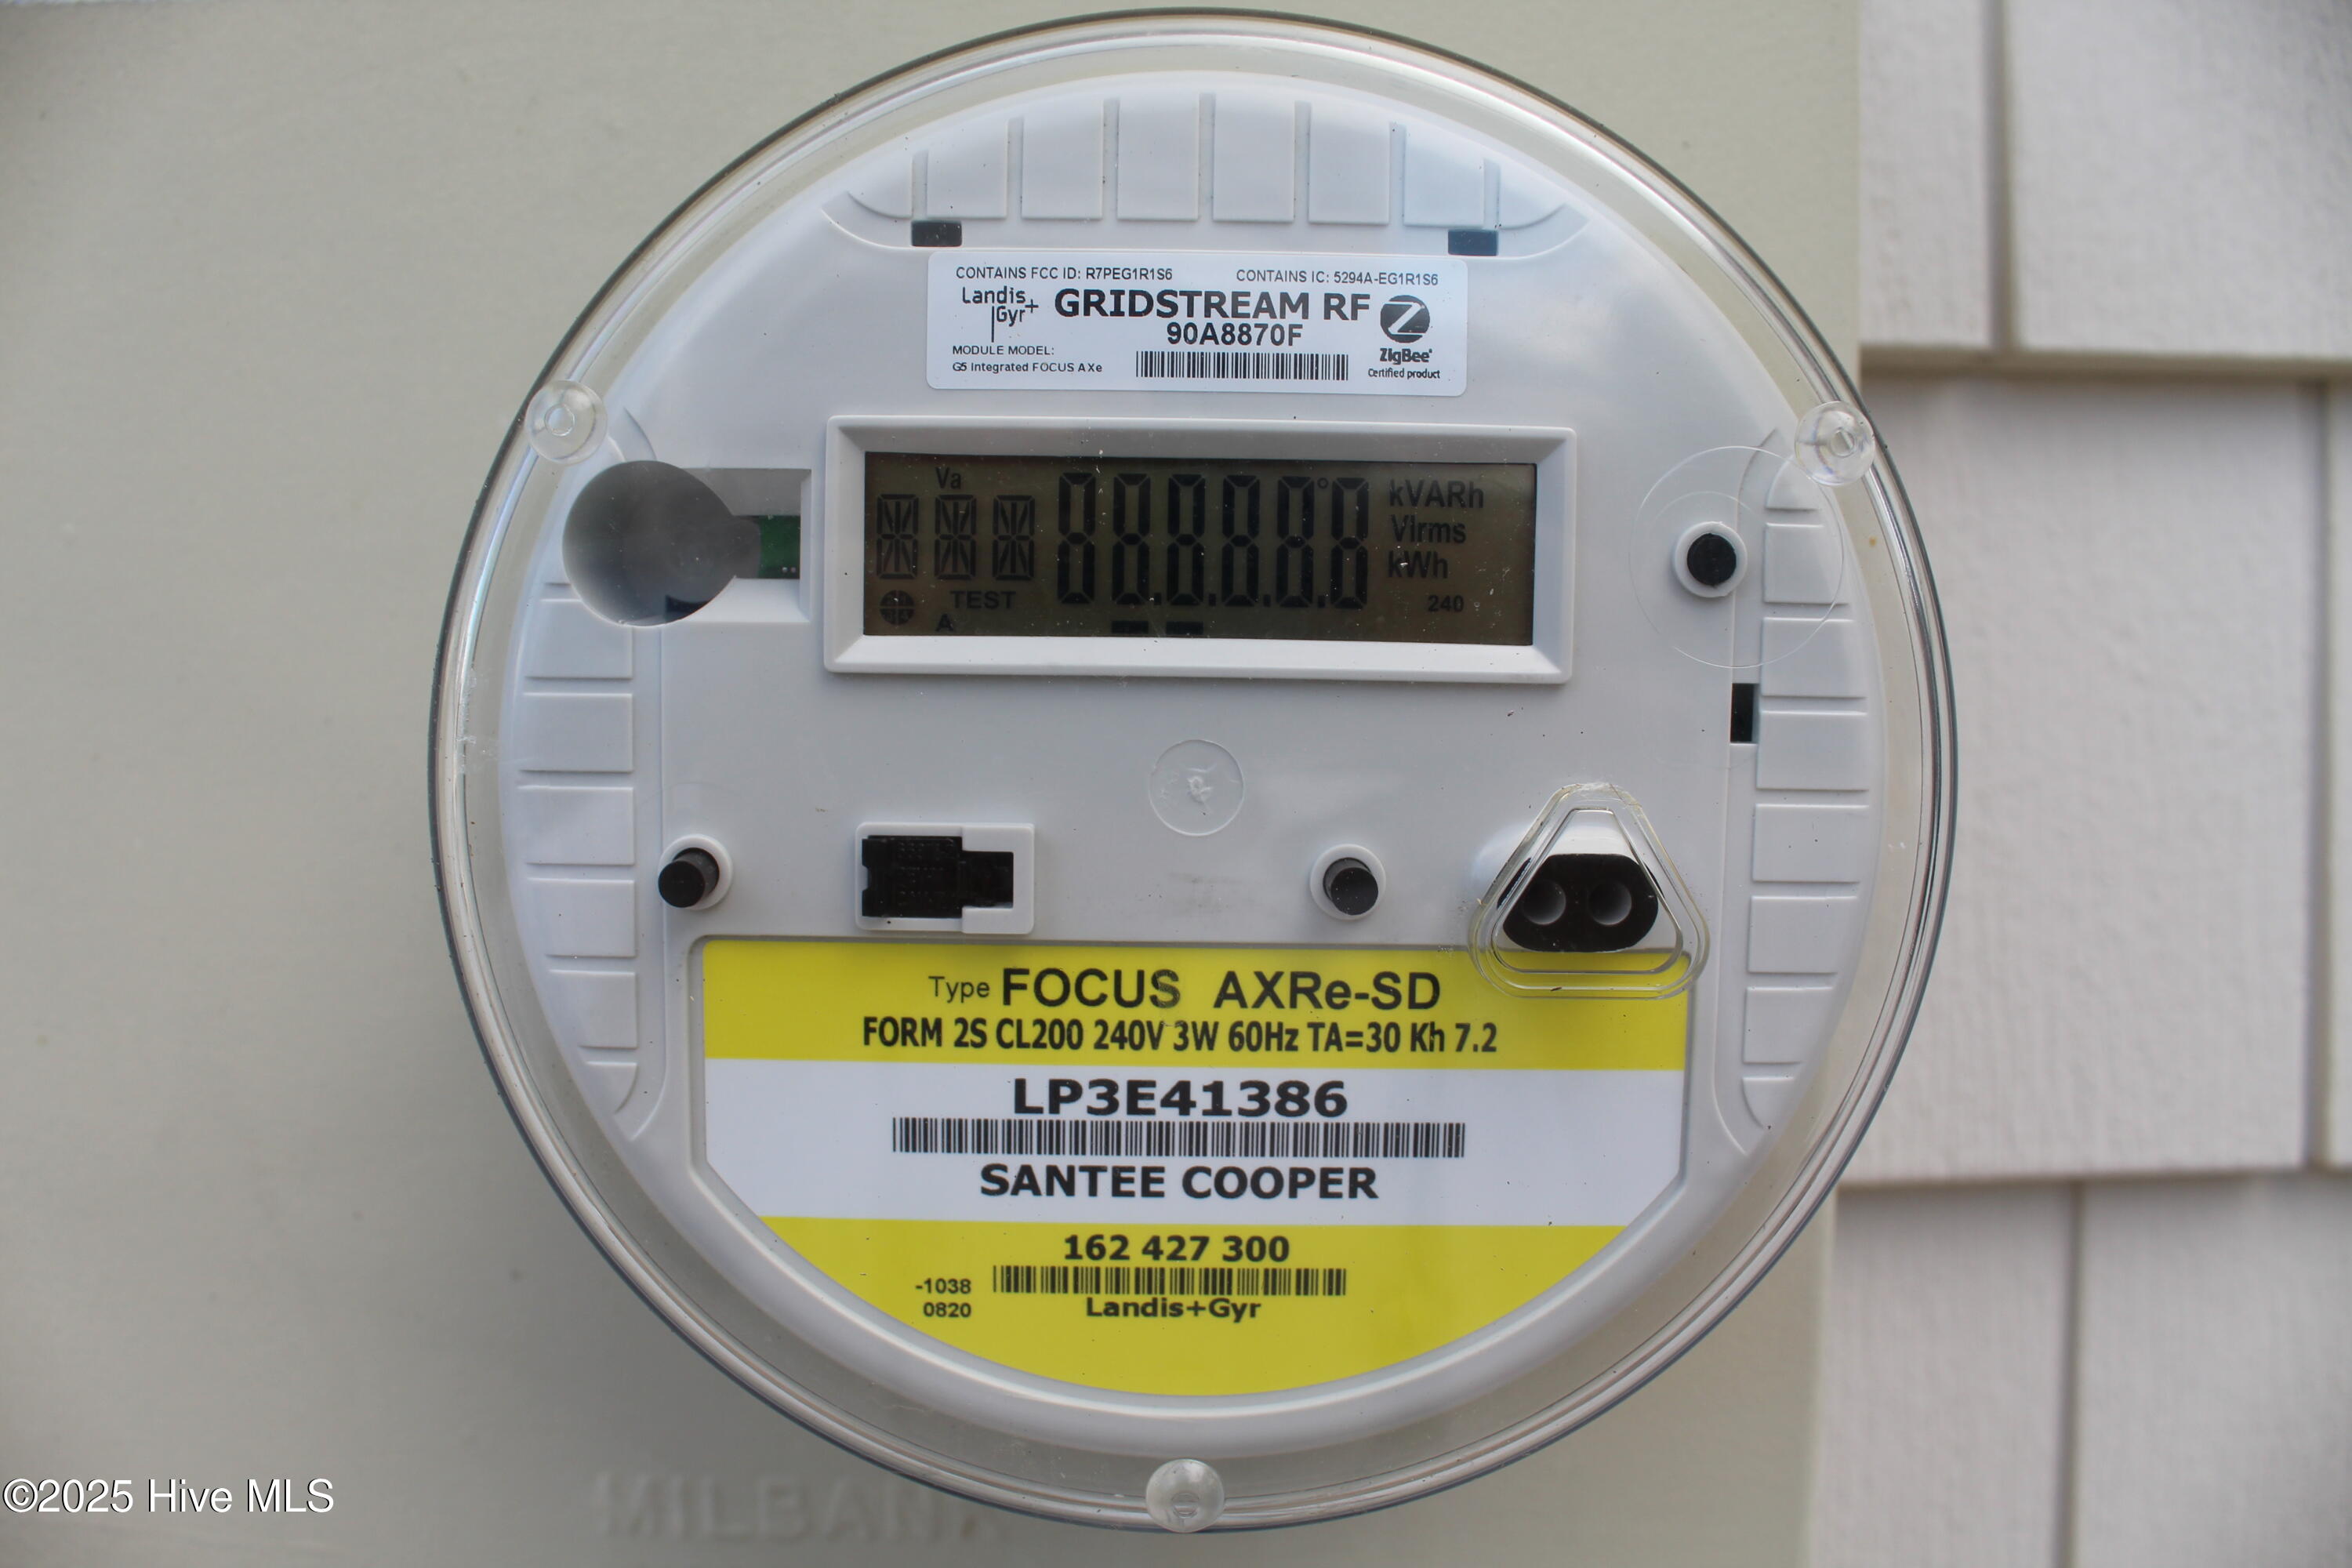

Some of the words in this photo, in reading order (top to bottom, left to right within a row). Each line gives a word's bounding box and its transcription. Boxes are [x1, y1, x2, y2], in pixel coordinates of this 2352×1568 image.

[956, 267, 1027, 279] CONTAINS
[1031, 267, 1058, 279] FCC
[1063, 267, 1080, 280] ID:
[1086, 267, 1173, 281] R7PEG1R1S6
[1236, 269, 1307, 283] CONTAINS
[1312, 270, 1329, 283] IC:
[1334, 270, 1439, 286] 5294A-EG1R1S6
[962, 285, 1026, 304] Landis
[1054, 288, 1309, 320] GRIDSTREAM
[1323, 292, 1370, 321] RF
[1167, 321, 1303, 347] 90A8870F
[953, 345, 1004, 355] MODULE
[1007, 345, 1054, 355] MODEL:
[952, 361, 967, 372] G5
[971, 362, 1029, 375] Integrated
[1032, 362, 1075, 372] FOCUS
[1367, 367, 1405, 379] Certified
[1406, 368, 1440, 379] product
[1388, 550, 1448, 579] kWh
[950, 590, 1016, 609] TEST
[1428, 594, 1465, 612] 240
[927, 975, 990, 1001] Type
[1003, 967, 1181, 1009] FOCUS
[1213, 971, 1441, 1011] AXRe-SD
[863, 1016, 942, 1047] FORM
[953, 1017, 988, 1049] 2S
[996, 1018, 1083, 1051] CL200
[1094, 1018, 1164, 1051] 240V
[1173, 1020, 1219, 1051] 3W
[1228, 1020, 1299, 1052] 60Hz
[1307, 1021, 1401, 1053] TA=30
[1410, 1022, 1445, 1052] Kh
[1454, 1022, 1497, 1053] 7.2
[1014, 1078, 1348, 1118] LP3E41386
[981, 1163, 1166, 1198] SANTEE
[1181, 1166, 1379, 1200] COOPER
[1065, 1234, 1131, 1261] 162
[1142, 1235, 1210, 1261] 427
[1222, 1235, 1290, 1263] 300
[915, 1277, 971, 1294] -1038
[923, 1301, 971, 1318] 0820
[1087, 1297, 1261, 1323] Landis+Gyr
